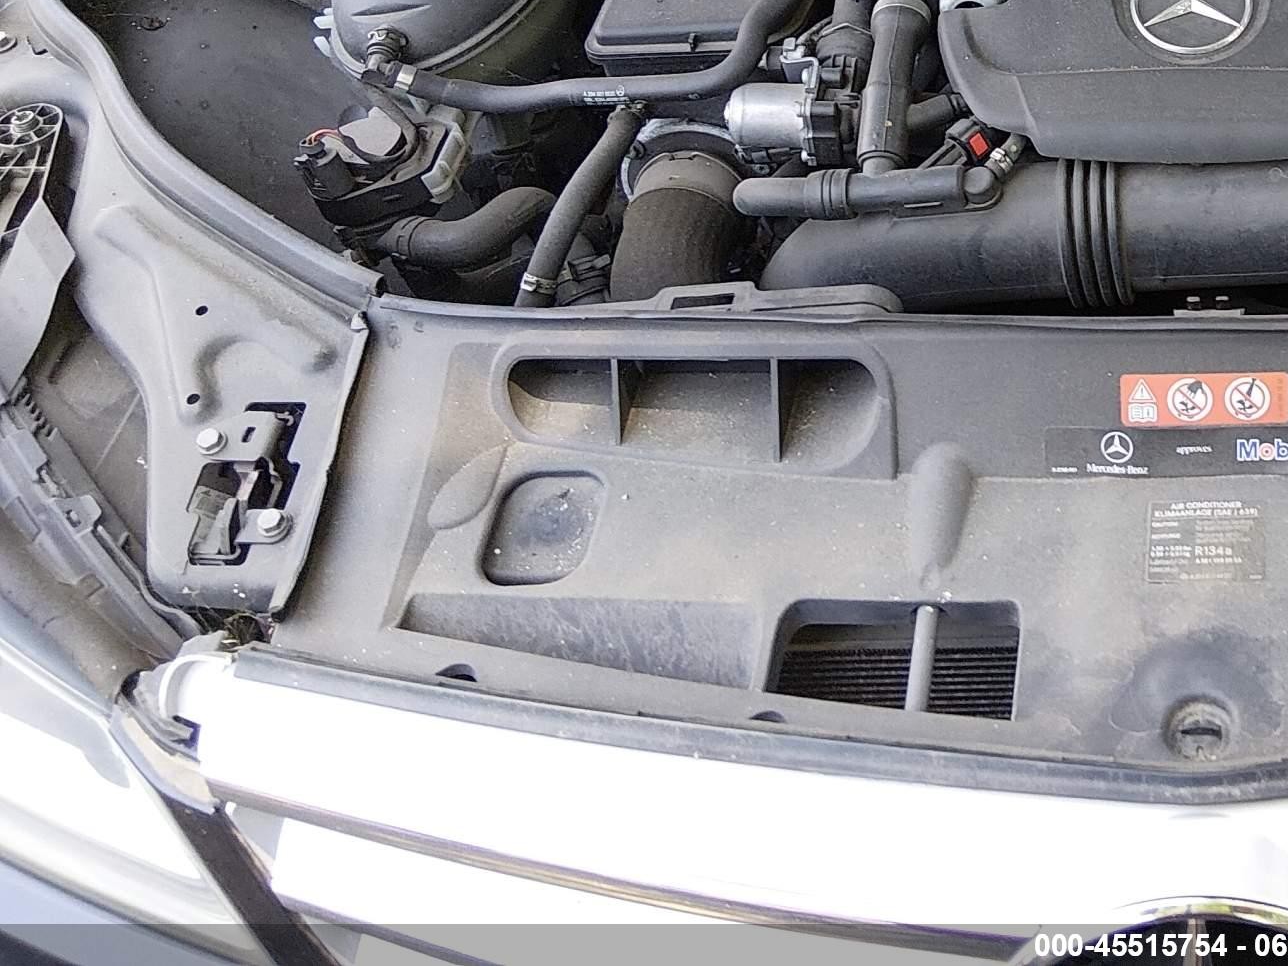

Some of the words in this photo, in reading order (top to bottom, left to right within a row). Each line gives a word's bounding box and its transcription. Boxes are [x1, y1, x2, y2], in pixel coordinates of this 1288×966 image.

[1086, 463, 1149, 475] Mercedes-Benz
[1170, 502, 1185, 510] AIR
[1185, 501, 1242, 509] CONDITIONER
